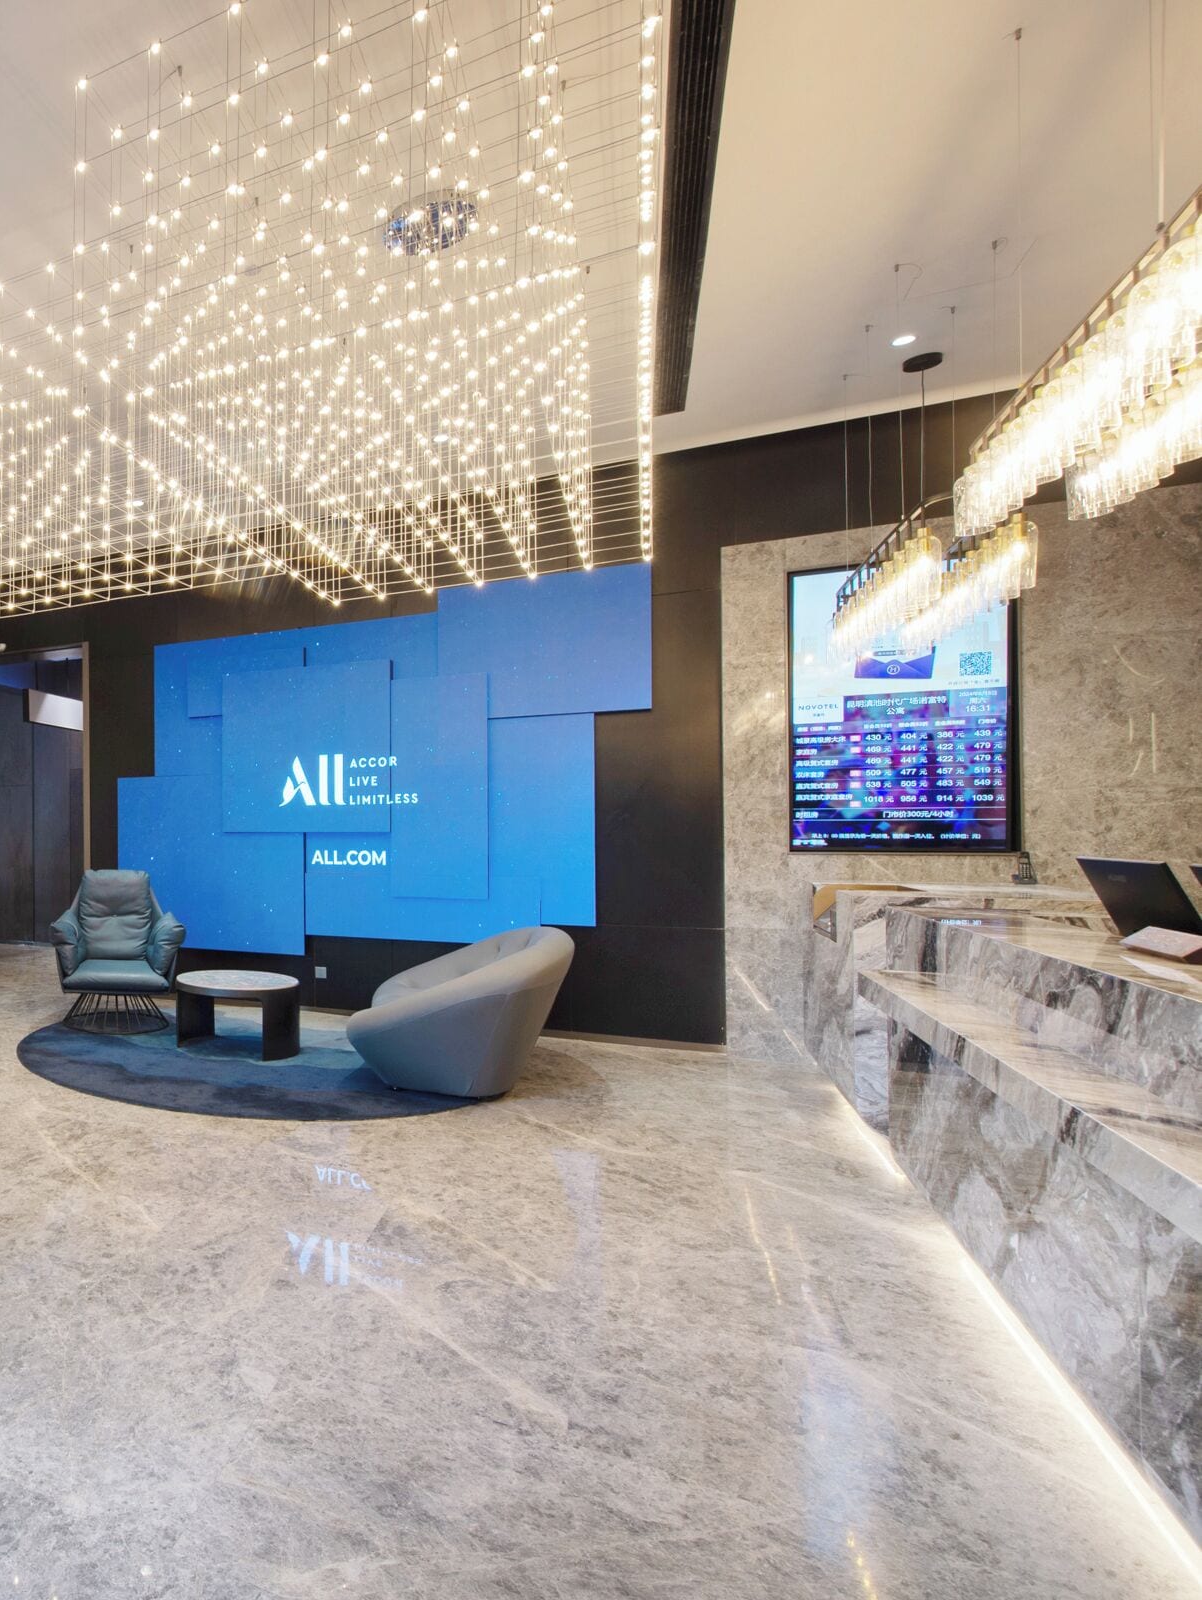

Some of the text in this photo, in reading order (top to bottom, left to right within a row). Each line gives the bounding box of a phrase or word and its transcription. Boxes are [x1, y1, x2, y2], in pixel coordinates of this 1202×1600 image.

[798, 703, 839, 711] NOVOTEL
[966, 704, 990, 712] 16:31
[349, 756, 398, 768] ACCOR
[349, 776, 378, 787] LIVE
[349, 793, 419, 806] LIMITLESS
[311, 850, 387, 866] ALL.COM
